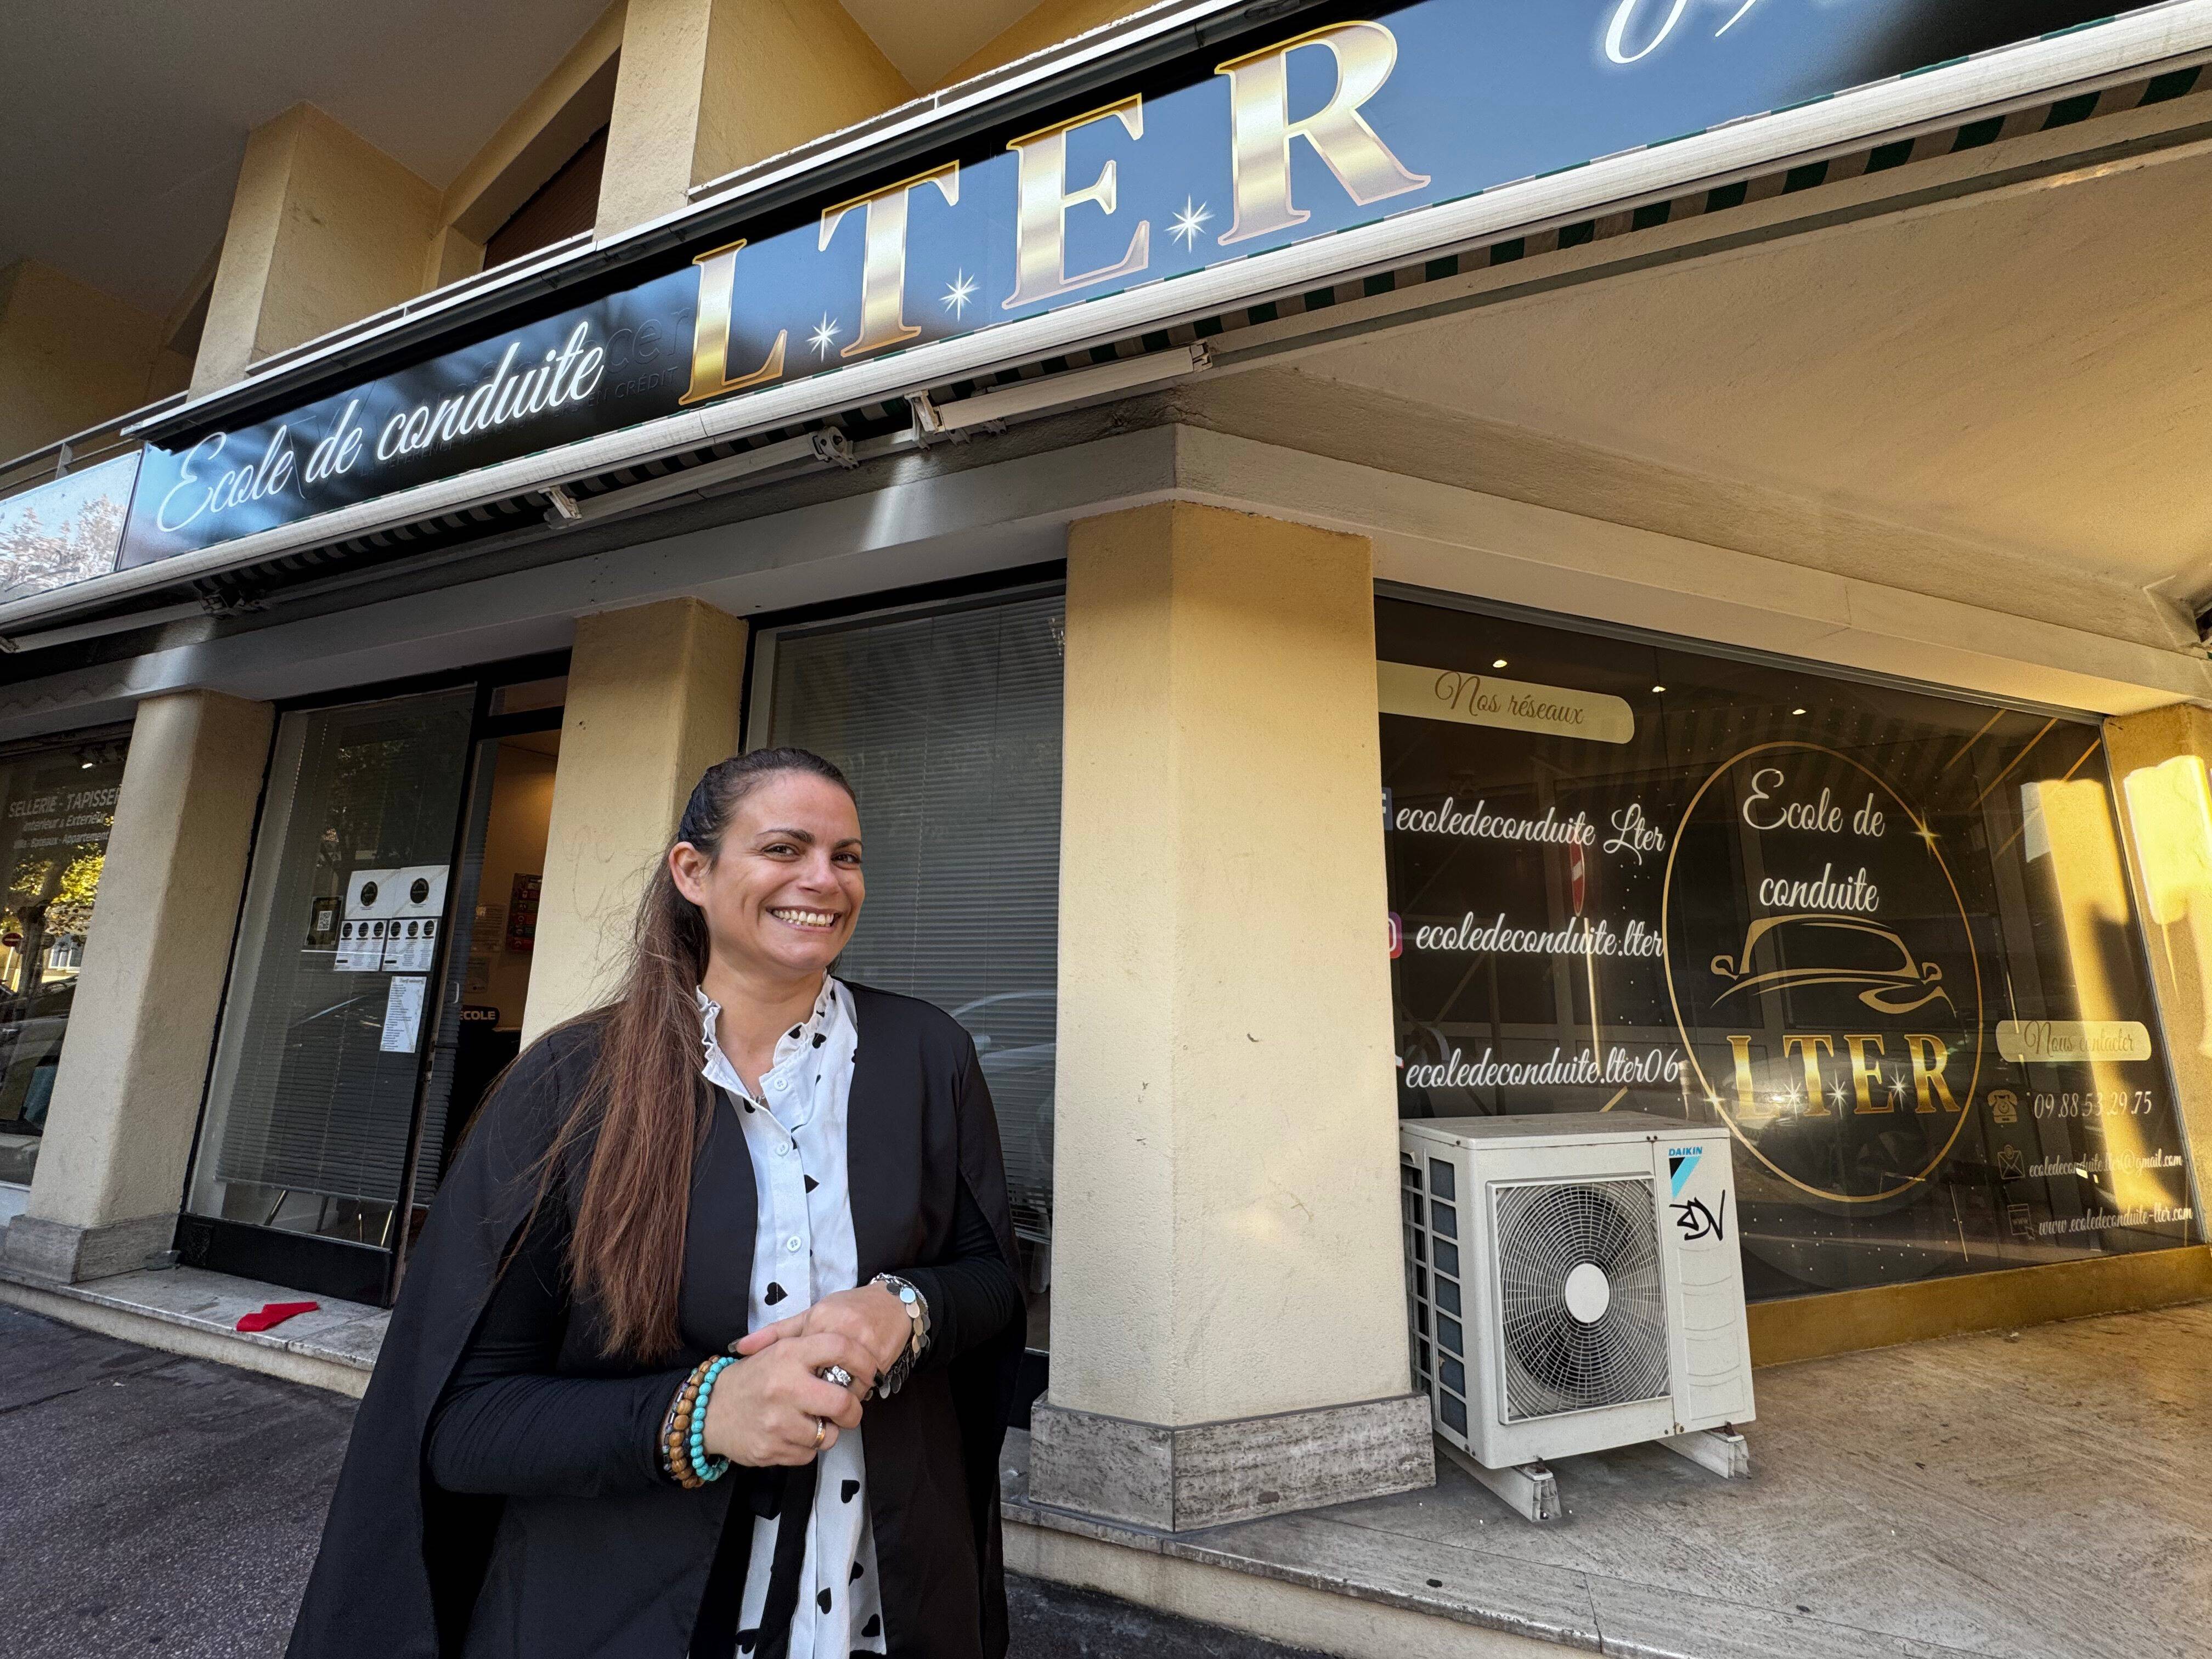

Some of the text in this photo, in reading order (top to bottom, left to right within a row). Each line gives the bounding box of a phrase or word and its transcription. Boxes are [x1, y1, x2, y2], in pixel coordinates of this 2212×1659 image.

[157, 424, 294, 532] Ecole
[305, 399, 363, 483] de
[377, 320, 605, 461] conduite
[1434, 671, 1584, 725] Nos réseaux
[9, 795, 58, 817] SELLERIE
[1742, 768, 1886, 837] Ecole de
[1396, 796, 1666, 866] ecoledeconduite Lter
[1759, 862, 1880, 912] conduite
[1416, 911, 1664, 957] ecoledeconduite.lter
[2024, 1020, 2074, 1058] Nous
[1405, 1046, 1679, 1088] ecoledeconduite.lter06
[1668, 1146, 1703, 1156] DAIKIN
